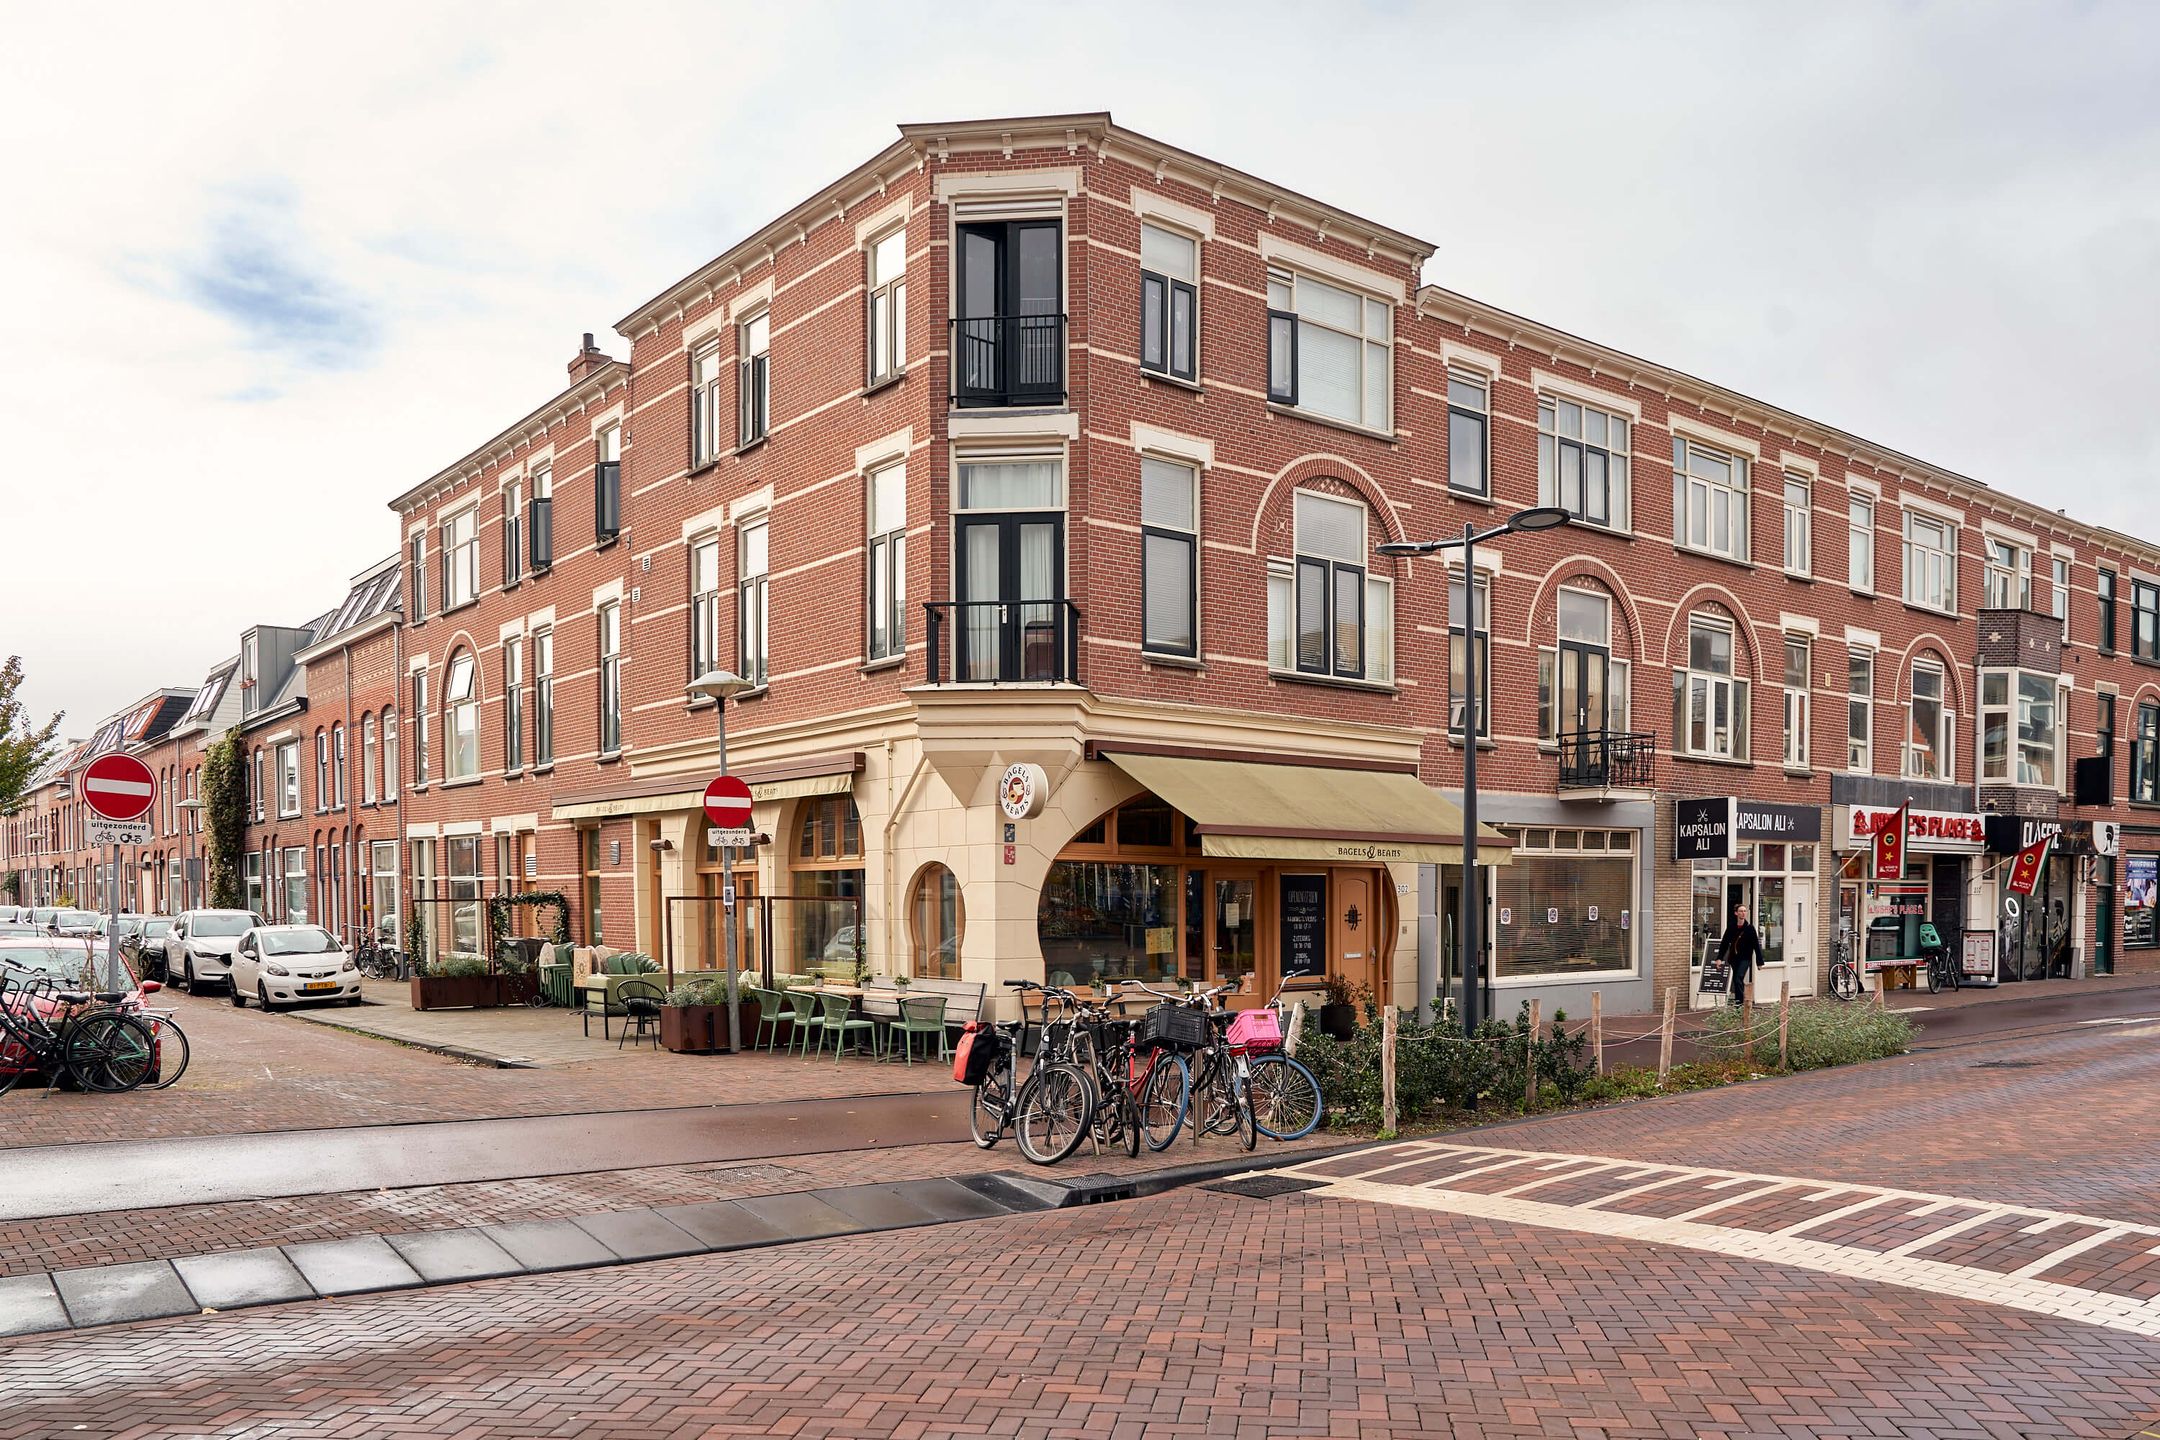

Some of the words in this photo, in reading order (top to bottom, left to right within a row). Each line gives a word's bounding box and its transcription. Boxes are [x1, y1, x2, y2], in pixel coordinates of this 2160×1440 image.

[1003, 766, 1029, 785] BAGELS
[1004, 799, 1029, 815] BEANS
[91, 822, 147, 831] uitgezonderd
[1680, 823, 1727, 837] KAPSALON
[1774, 814, 1787, 832] ALI
[1927, 815, 1972, 839] PLACE
[1695, 837, 1710, 851] ALI
[1338, 847, 1367, 857] BAGELS
[1377, 848, 1402, 858] BEANS
